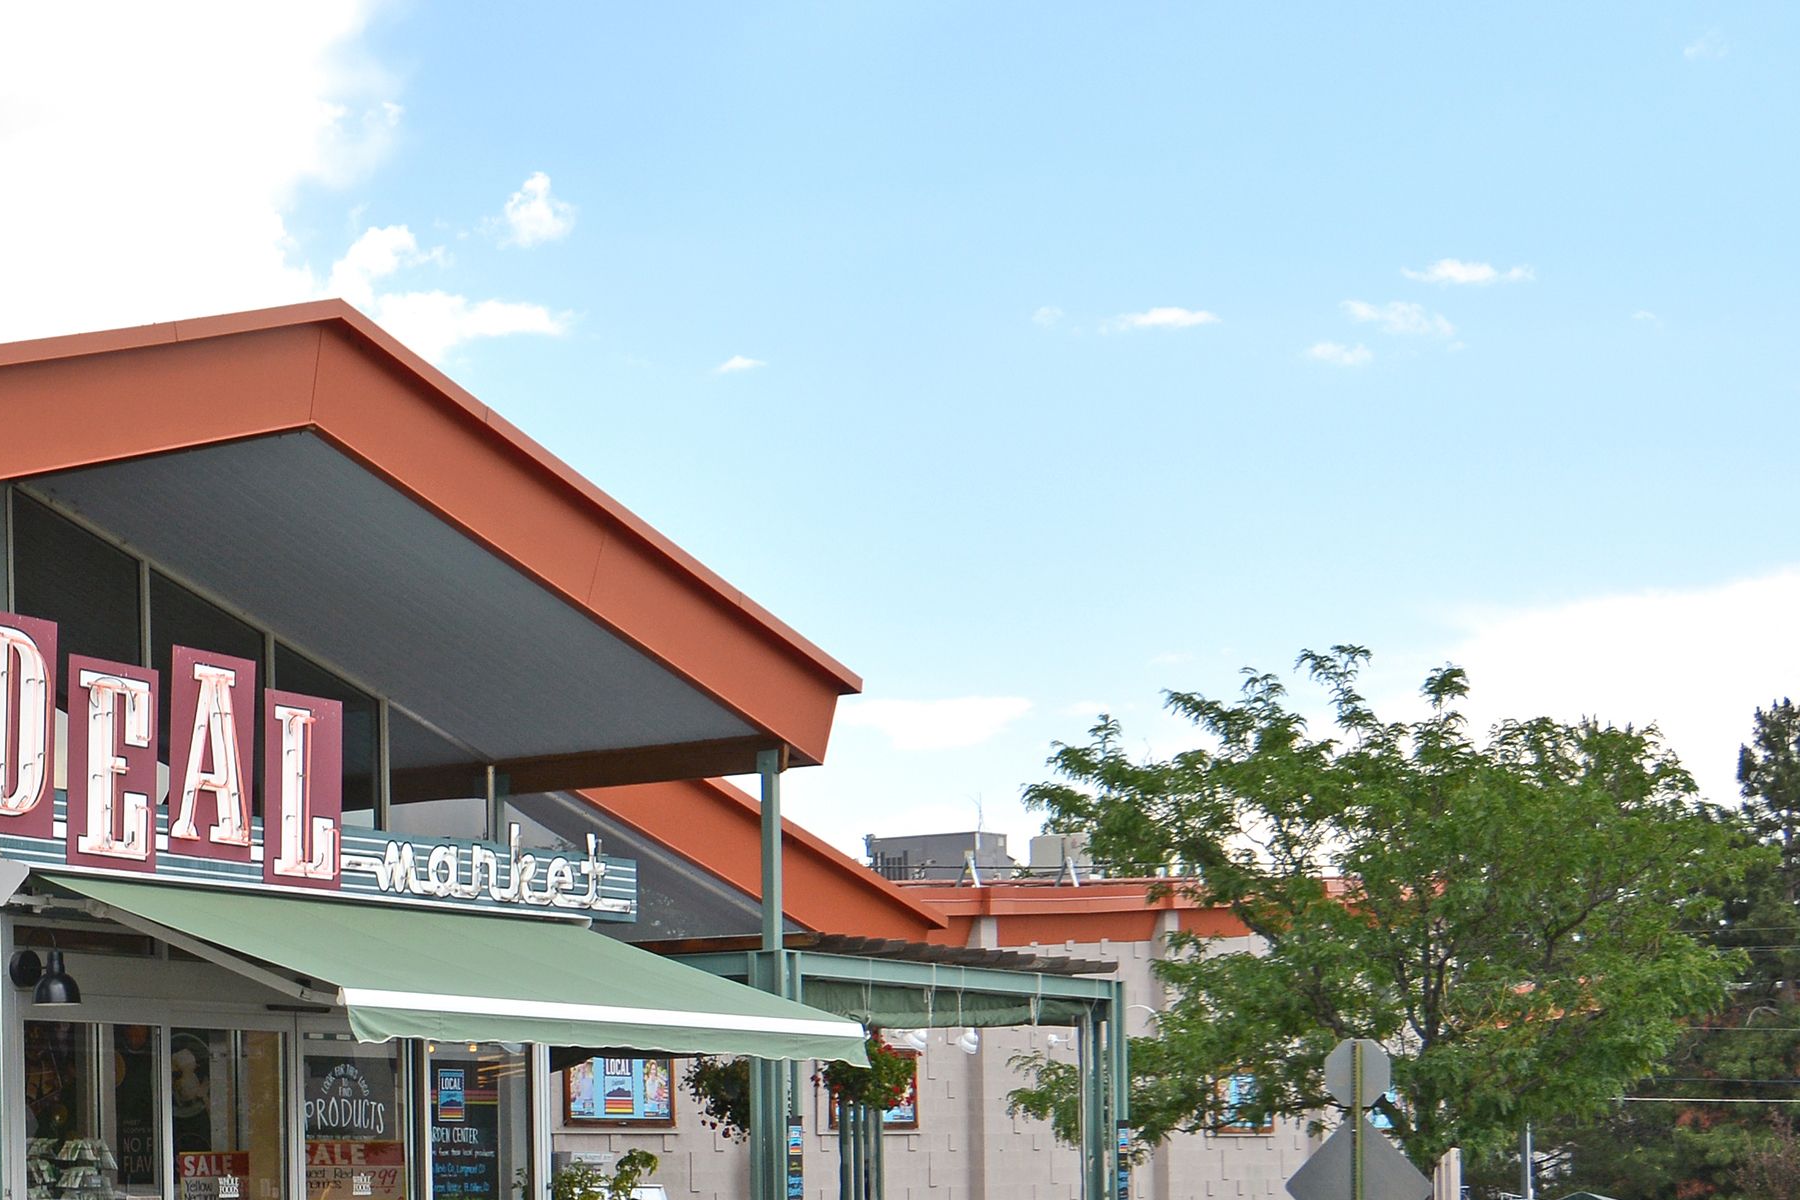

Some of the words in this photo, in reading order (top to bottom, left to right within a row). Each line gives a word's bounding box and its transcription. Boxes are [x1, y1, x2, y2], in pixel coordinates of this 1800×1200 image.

[606, 1059, 631, 1076] LOCAL
[441, 1077, 461, 1090] LOCAL
[304, 1096, 385, 1134] PRODUCTS
[432, 1127, 450, 1143] RDEN
[453, 1127, 478, 1144] CENTER
[123, 1156, 152, 1174] FLAV
[184, 1155, 232, 1176] SALE
[185, 1180, 213, 1193] Yellow
